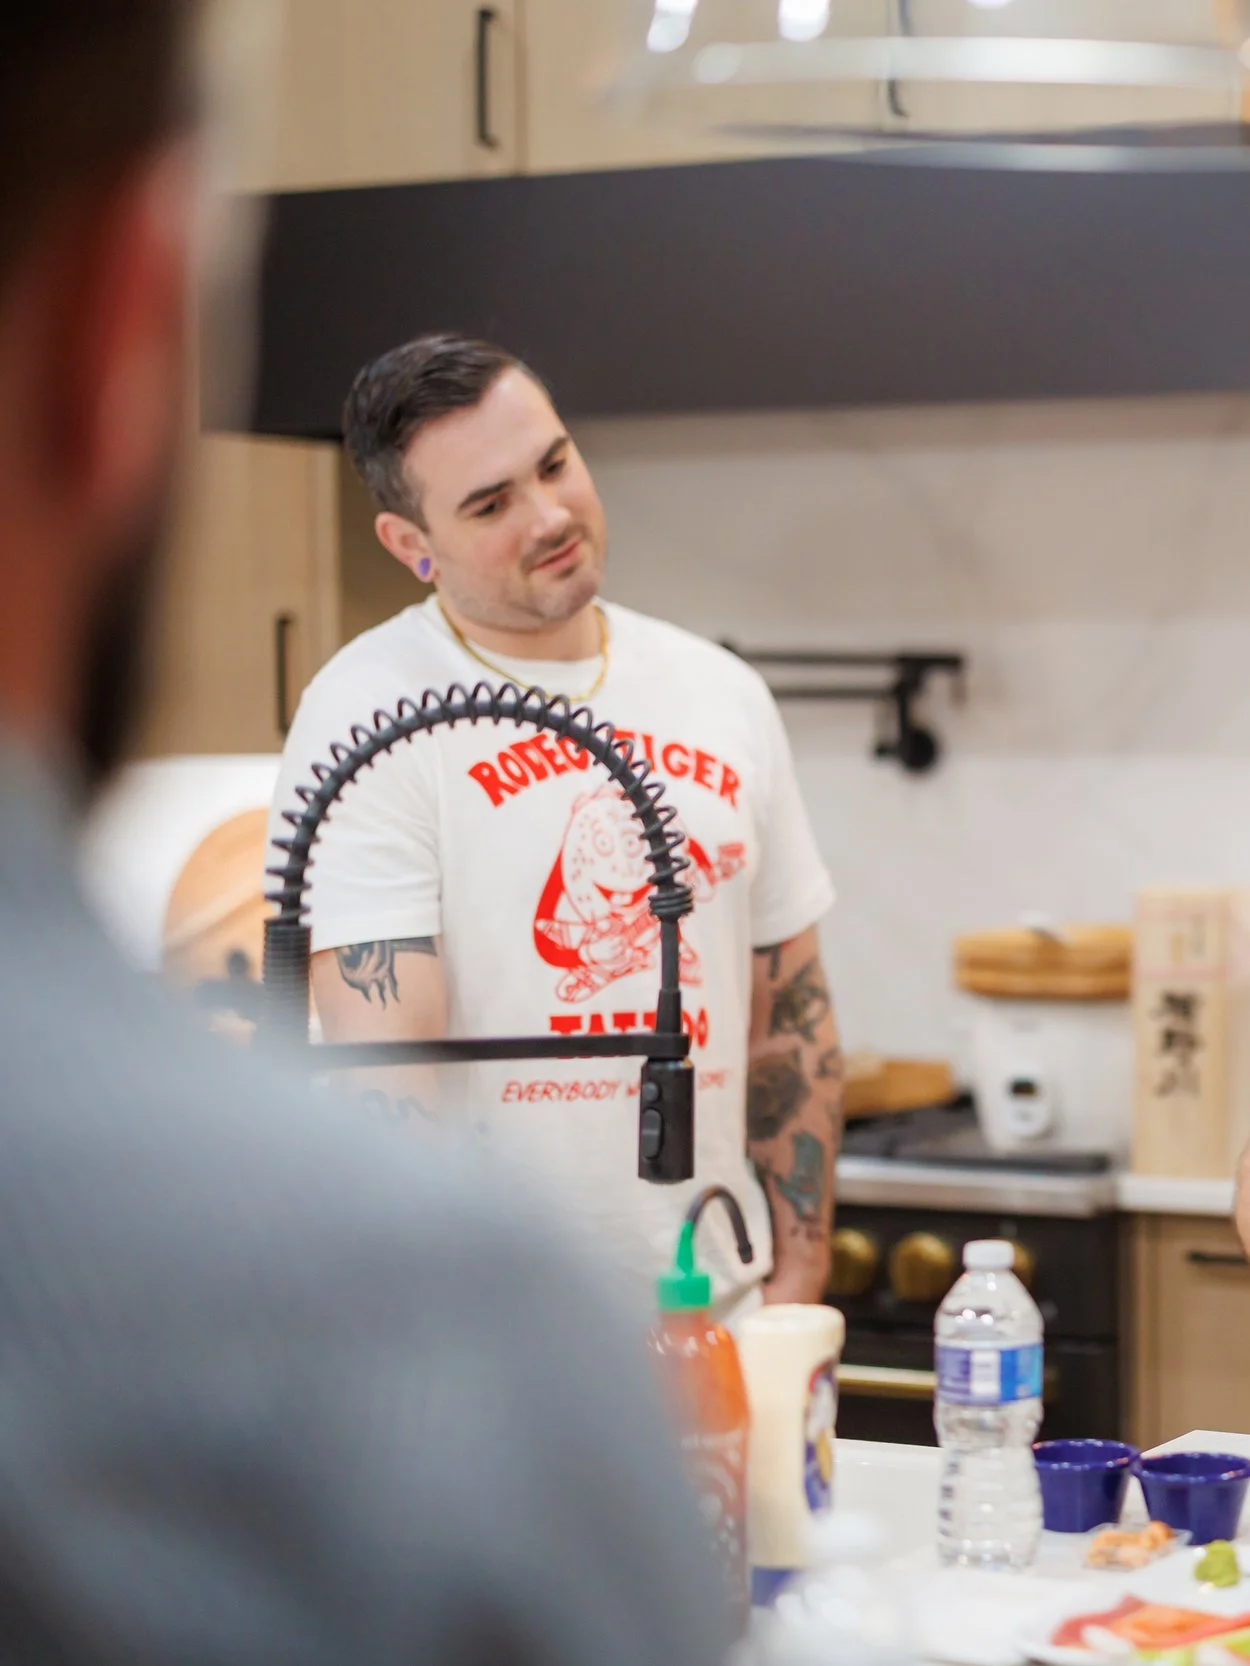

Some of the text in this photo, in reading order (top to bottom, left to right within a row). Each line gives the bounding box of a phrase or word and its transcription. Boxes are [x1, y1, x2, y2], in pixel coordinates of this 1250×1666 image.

[468, 727, 740, 807] RODEO TIGER
[501, 1079, 621, 1103] EVERYBODY
